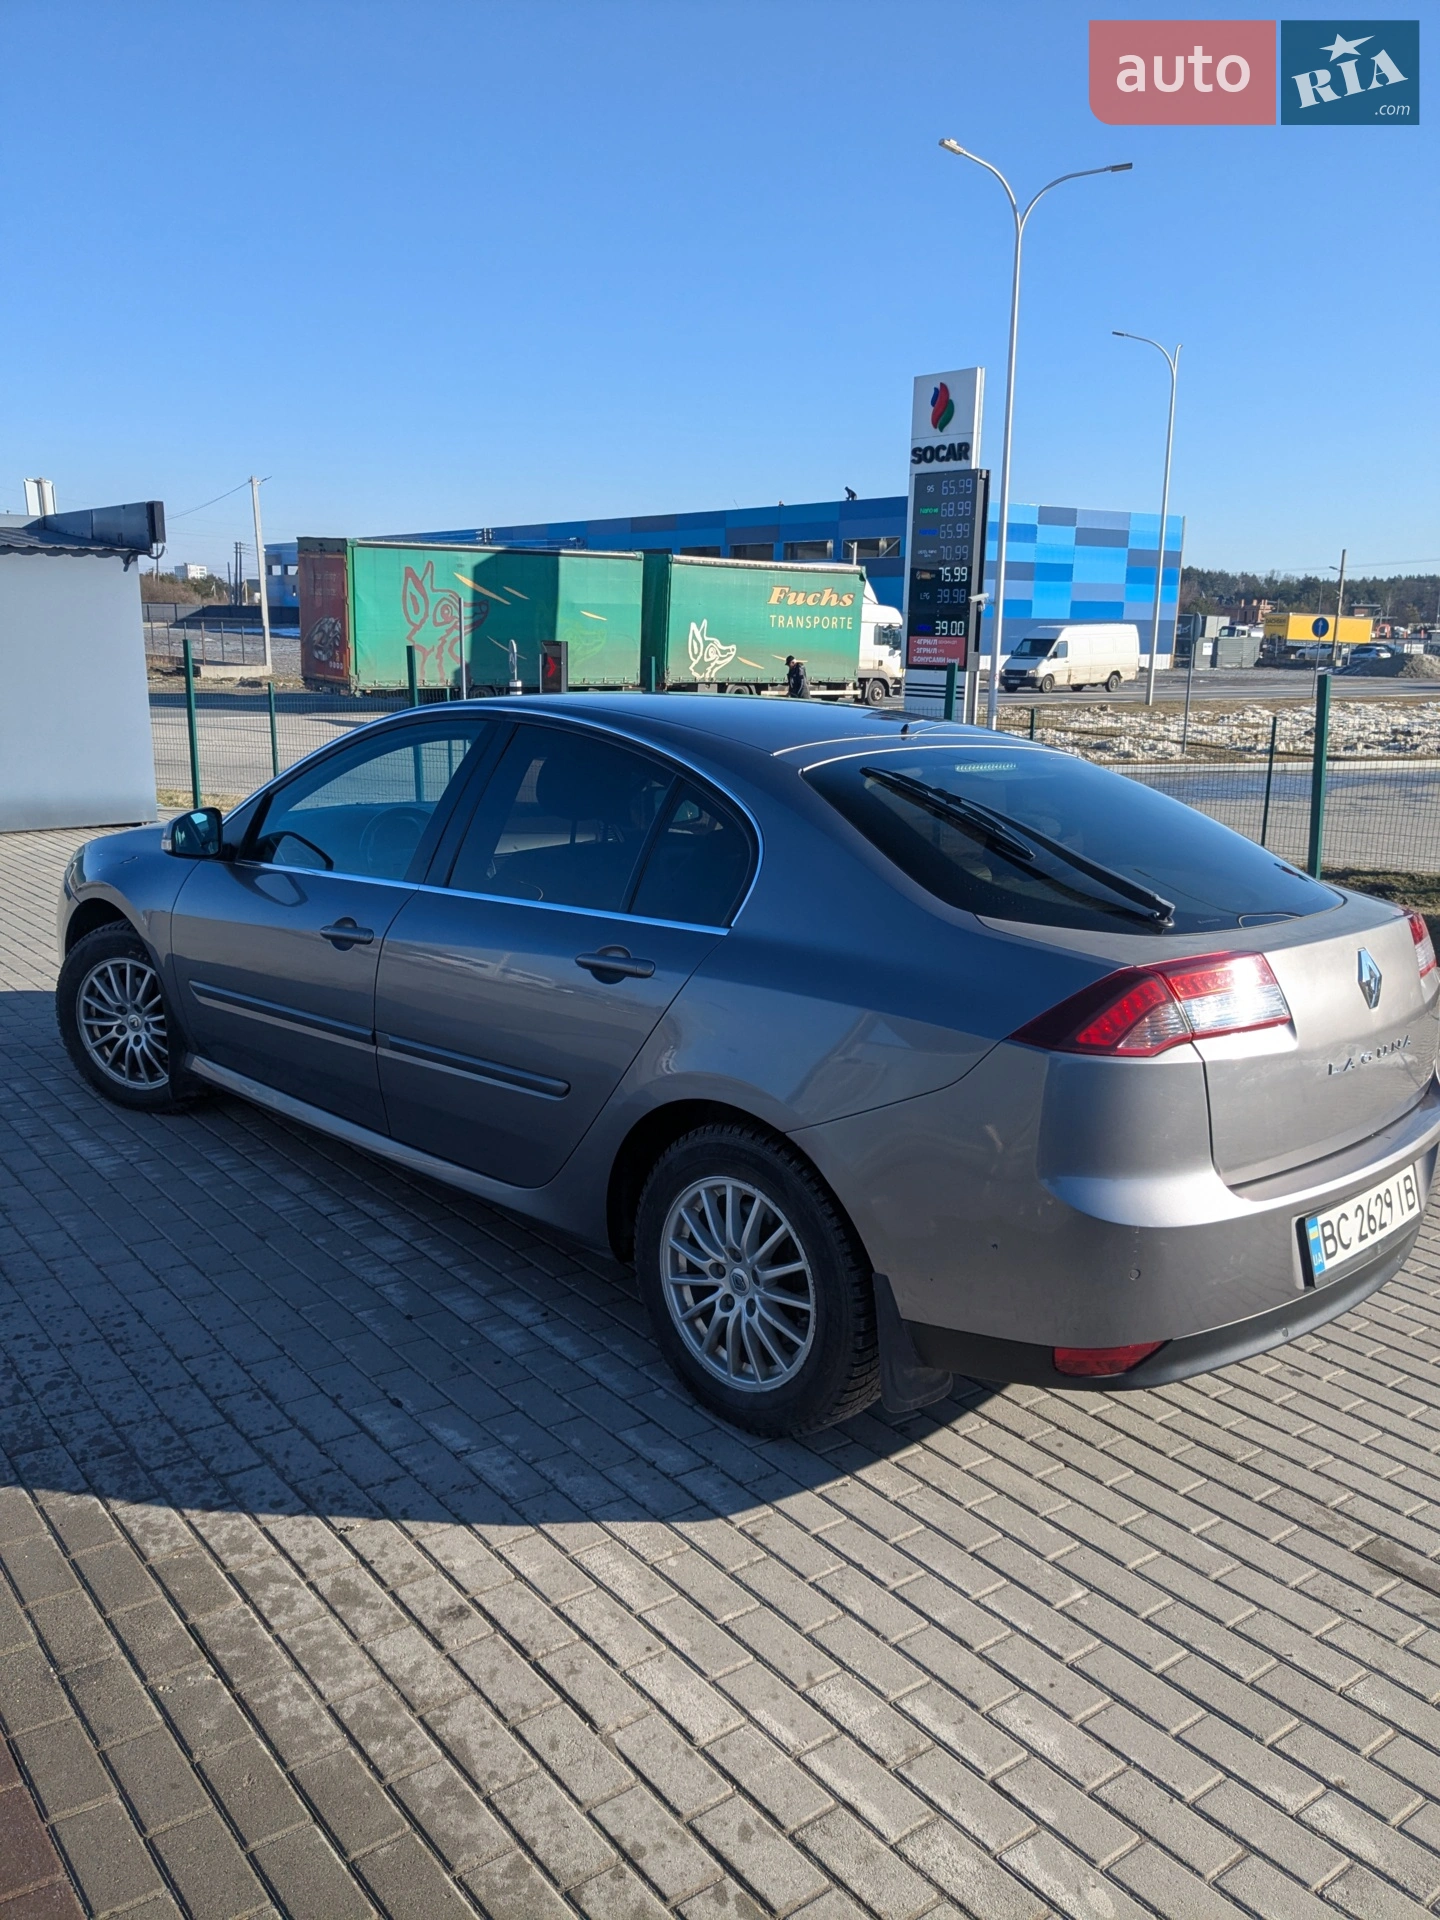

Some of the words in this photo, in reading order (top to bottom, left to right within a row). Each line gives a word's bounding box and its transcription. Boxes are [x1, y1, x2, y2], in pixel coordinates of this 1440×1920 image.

[911, 442, 970, 465] SOCAR
[926, 484, 935, 493] 95
[941, 479, 973, 496] 65.99
[940, 501, 972, 518] 68.99
[940, 523, 970, 539] 65.99
[939, 545, 969, 560] 70.99
[938, 566, 968, 582] 75.99
[767, 585, 855, 608] Fuchs
[937, 588, 967, 604] 39.98
[769, 615, 853, 630] TRANSPORTE
[934, 620, 965, 636] 39.00
[1328, 1034, 1411, 1076] LAGUNA
[1320, 1212, 1353, 1261] BC
[1354, 1188, 1394, 1244] 2629
[1396, 1174, 1416, 1216] IB
[1312, 1252, 1324, 1267] UA
